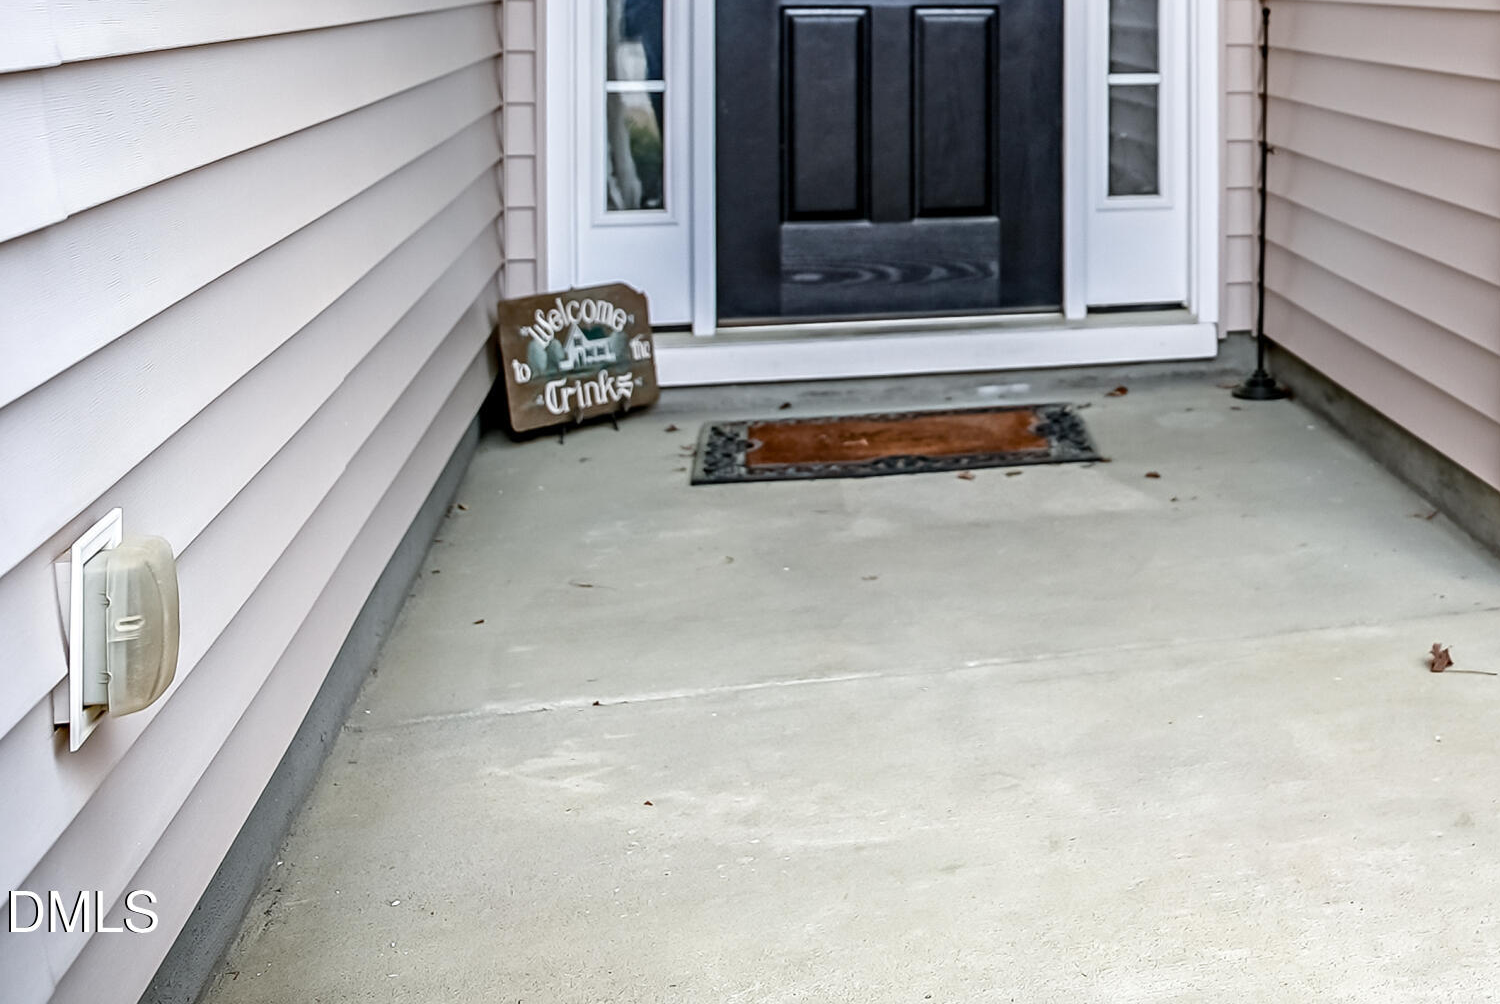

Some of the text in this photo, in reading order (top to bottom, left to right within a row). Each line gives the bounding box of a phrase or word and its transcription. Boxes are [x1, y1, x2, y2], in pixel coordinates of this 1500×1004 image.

[527, 297, 627, 347] Welcome
[511, 334, 651, 384] to the
